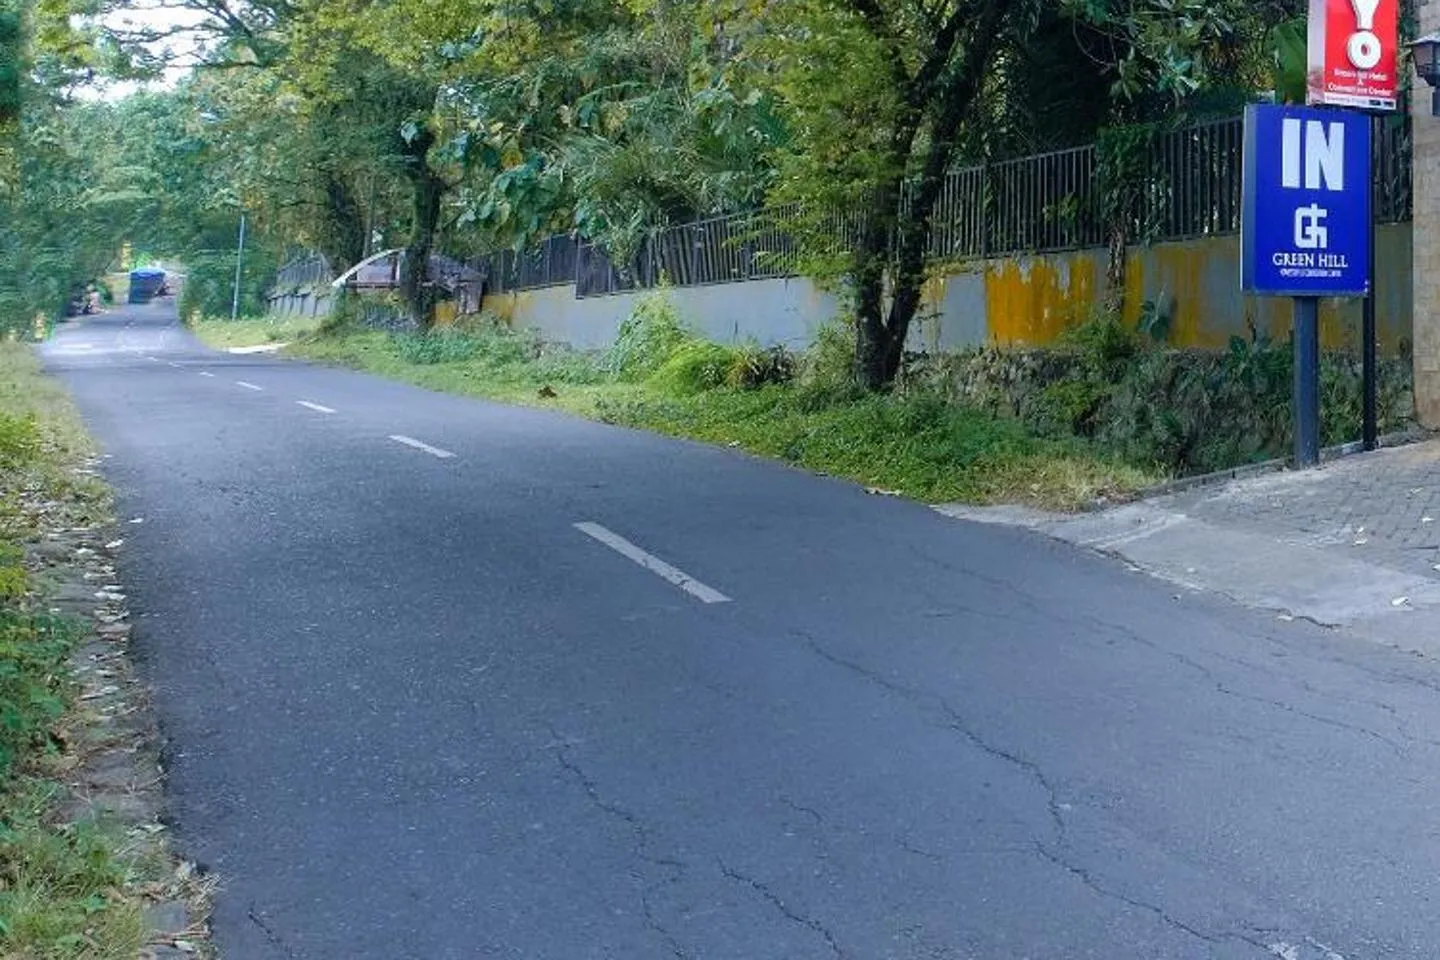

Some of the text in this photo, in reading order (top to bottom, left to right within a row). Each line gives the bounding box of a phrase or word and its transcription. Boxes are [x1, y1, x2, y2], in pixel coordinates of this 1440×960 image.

[1282, 118, 1345, 191] IN
[1272, 252, 1349, 268] GREEN HILL
